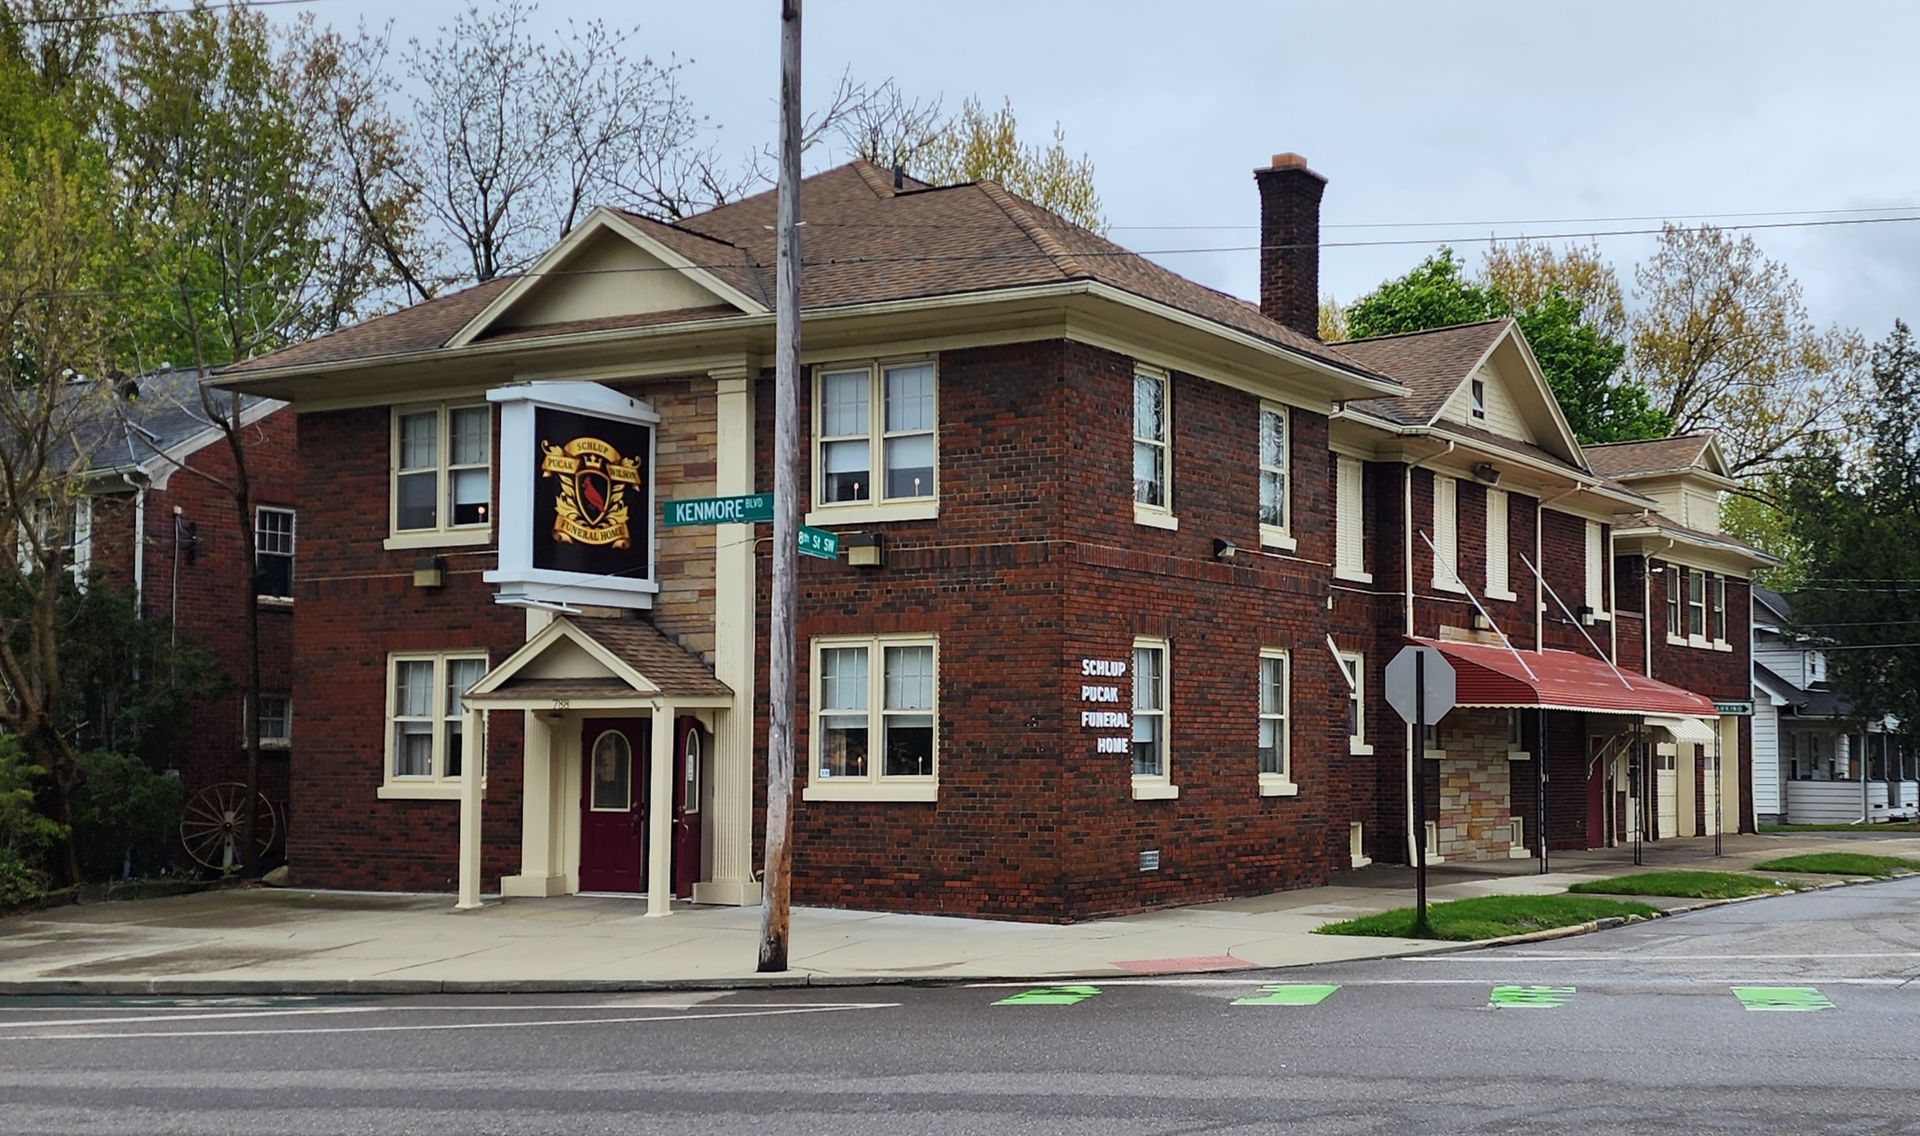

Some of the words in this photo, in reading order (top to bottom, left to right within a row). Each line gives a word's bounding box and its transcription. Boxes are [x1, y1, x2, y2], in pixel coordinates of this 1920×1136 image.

[576, 441, 609, 454] SCHLUP
[547, 458, 574, 470] PUCAK
[609, 467, 637, 481] WILSON
[675, 499, 745, 522] KENMORE
[745, 497, 763, 509] BLVD
[560, 519, 599, 541] FUNERAL
[600, 526, 624, 540] HOME
[812, 534, 821, 550] St
[823, 537, 836, 553] SW
[1081, 658, 1126, 677] SCHLUP
[1081, 685, 1118, 702] PUCAK
[1081, 711, 1130, 728] FUNERAL
[1097, 737, 1128, 753] HOME
